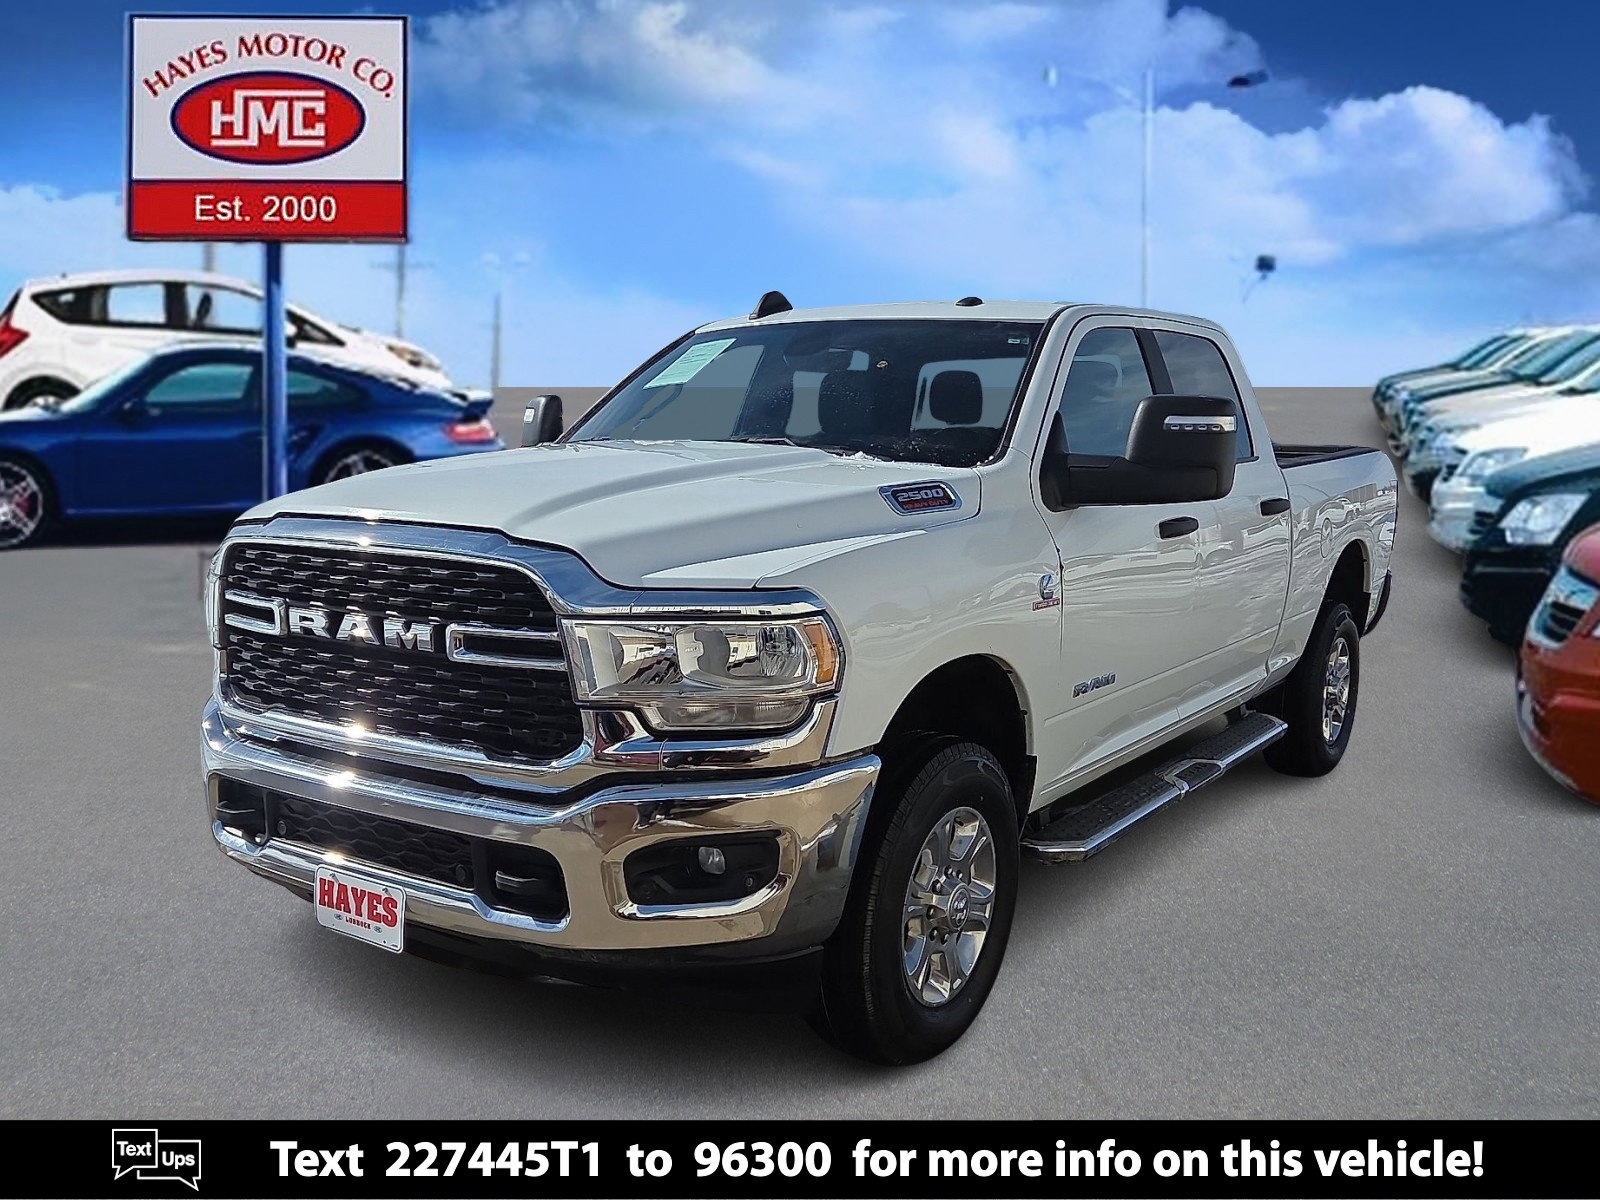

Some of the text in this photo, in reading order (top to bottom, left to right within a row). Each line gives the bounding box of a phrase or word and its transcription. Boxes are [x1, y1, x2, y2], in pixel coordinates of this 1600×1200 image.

[142, 32, 396, 99] HAYES MOTOR CO.
[209, 88, 326, 148] HMC
[194, 194, 337, 223] Est. 2000
[895, 488, 944, 502] 2500
[288, 606, 435, 652] RAM
[318, 877, 398, 928] HAYES
